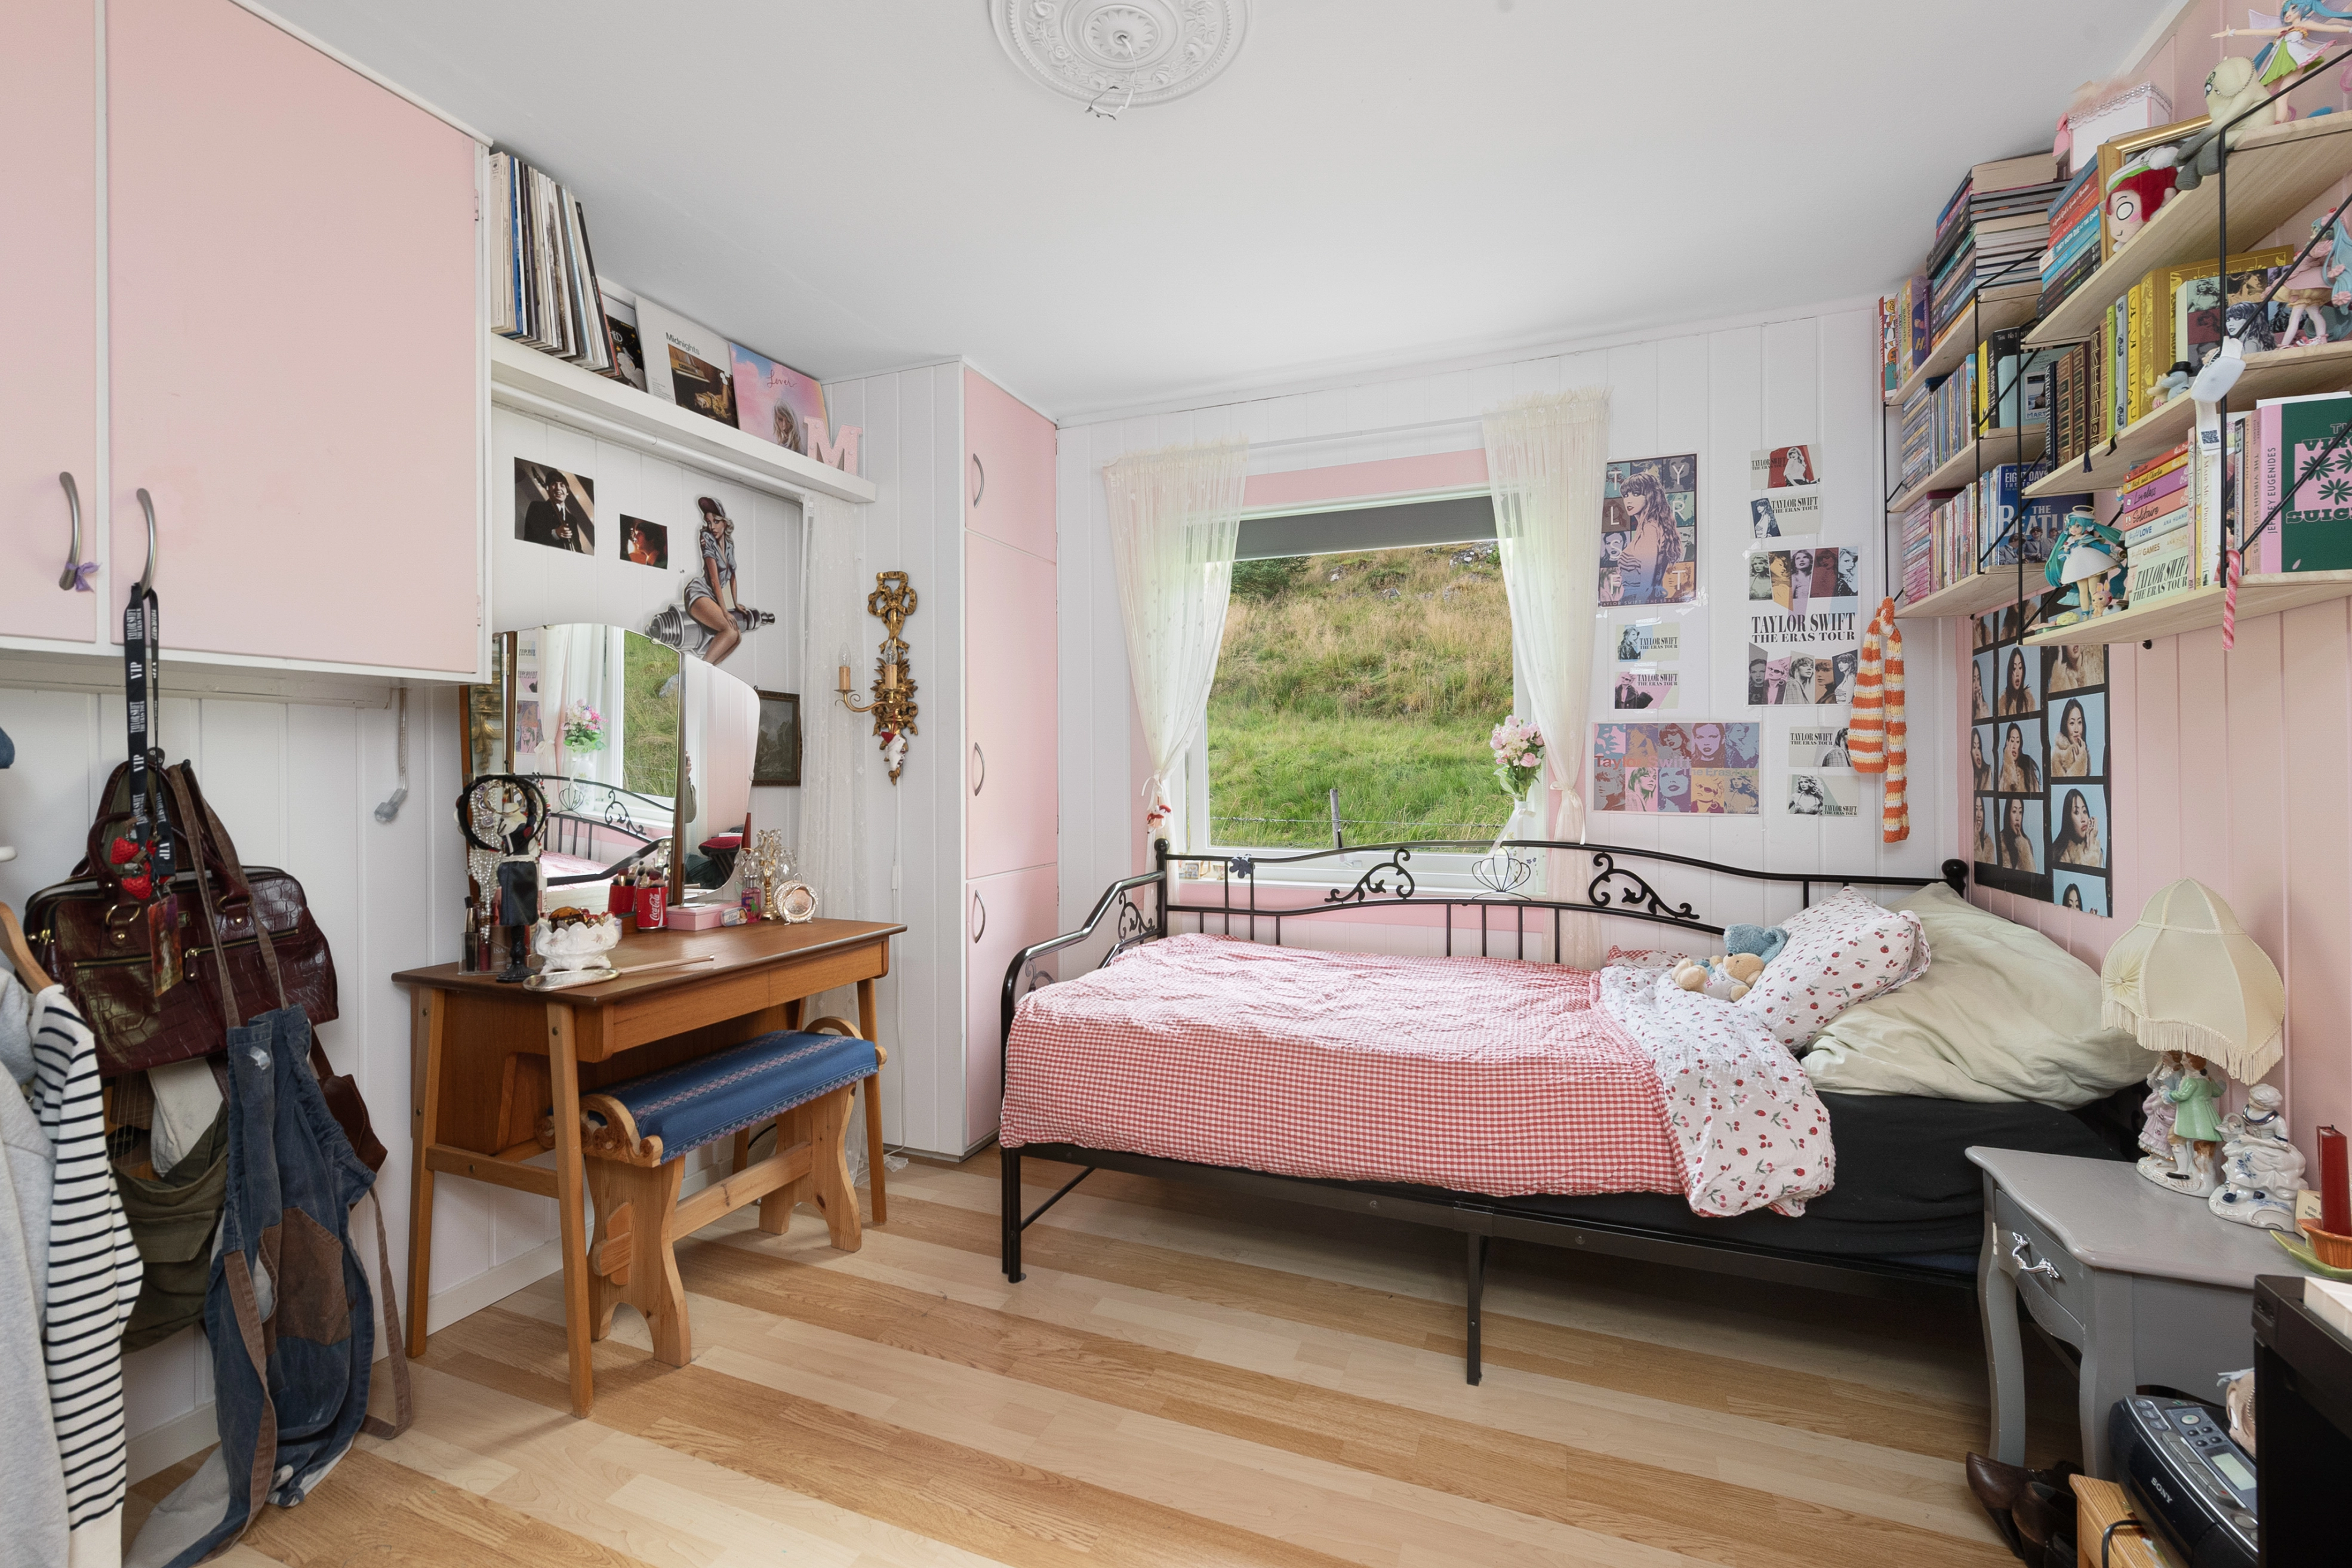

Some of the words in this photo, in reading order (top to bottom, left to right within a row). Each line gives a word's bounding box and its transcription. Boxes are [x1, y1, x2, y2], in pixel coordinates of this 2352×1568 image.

[666, 332, 700, 355] Midnights
[766, 369, 797, 388] Lover
[2005, 472, 2026, 483] EIGT
[2149, 468, 2163, 479] Charlie
[2267, 448, 2276, 497] EUGENIDES
[2134, 484, 2157, 505] Loveless
[2203, 486, 2209, 498] ME
[1771, 498, 1796, 509] TAYLOR
[1797, 497, 1818, 507] SWIFT
[2032, 505, 2051, 515] THE
[1999, 505, 2067, 539] BEATL
[2133, 506, 2159, 523] Solitaire
[2139, 526, 2153, 537] LOVE
[2142, 543, 2160, 556] GAMES
[2135, 562, 2166, 591] TAYLOR
[2133, 589, 2145, 602] THE
[2147, 582, 2166, 597] ERAS
[2168, 575, 2188, 592] TOUR
[1751, 615, 1806, 634] TAYLOR
[1811, 612, 1855, 631] SWIFT
[1752, 634, 1778, 643] THE
[1781, 633, 1815, 642] ERAS
[1819, 631, 1855, 641] TOUR
[130, 661, 143, 679] VIP
[133, 754, 144, 772] VIP
[159, 842, 170, 860] VIP
[649, 893, 660, 921] Coca-Cola
[2151, 1477, 2173, 1504] SONY
